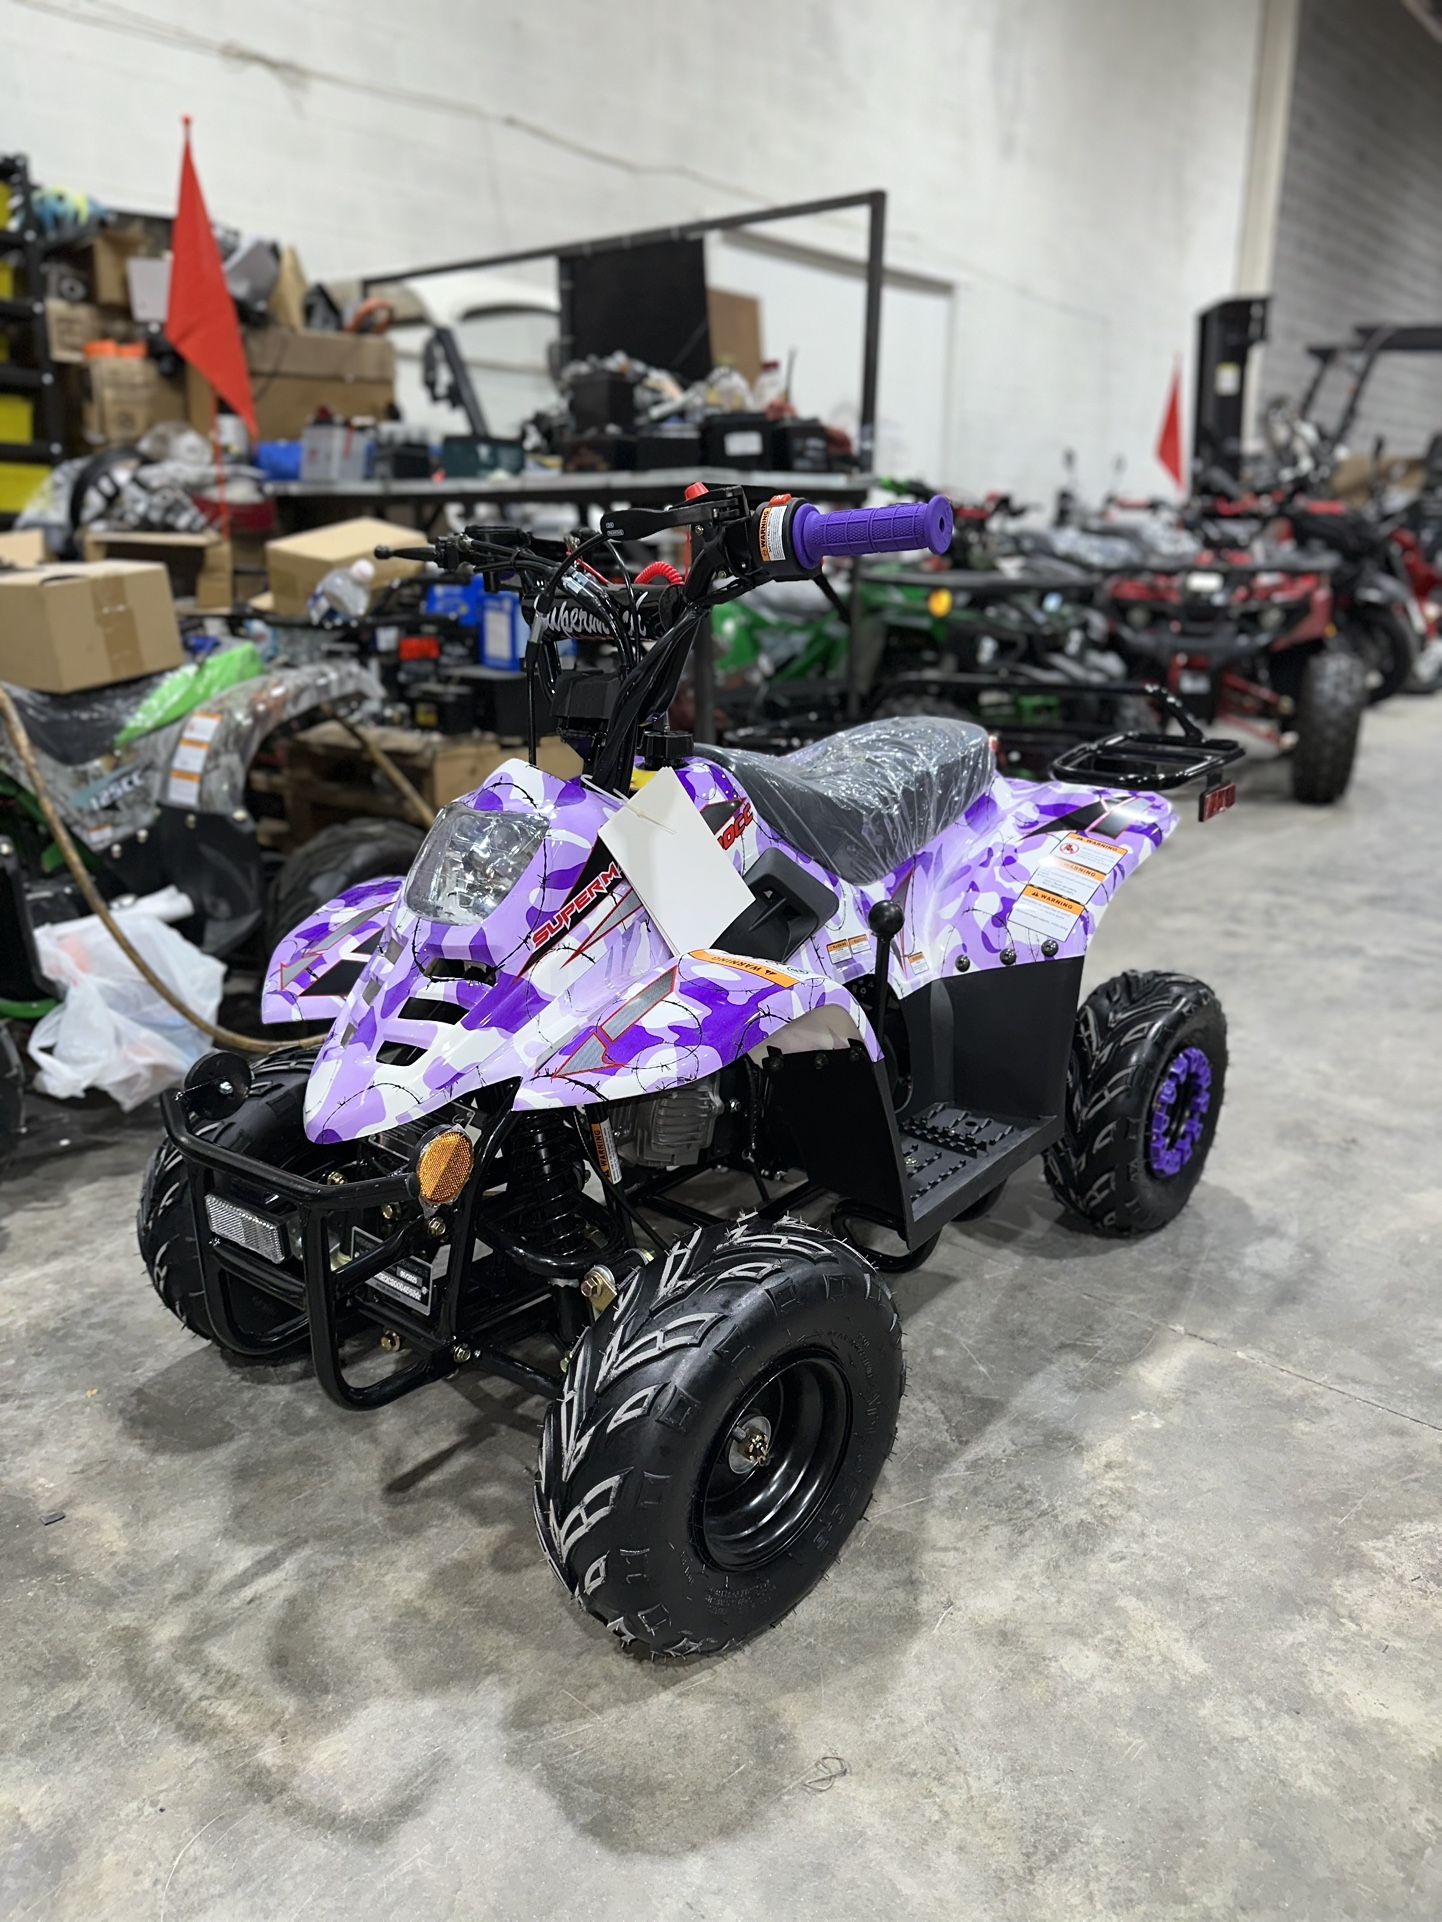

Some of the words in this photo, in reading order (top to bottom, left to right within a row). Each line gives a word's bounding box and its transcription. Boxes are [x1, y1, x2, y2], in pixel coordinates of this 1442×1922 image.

[760, 511, 769, 548] WARNING
[1085, 838, 1119, 852] WARNING
[531, 860, 622, 949] SUPERM
[1040, 893, 1073, 910] WARNING
[711, 956, 762, 972] WARNING
[594, 1130, 608, 1167] WARNING
